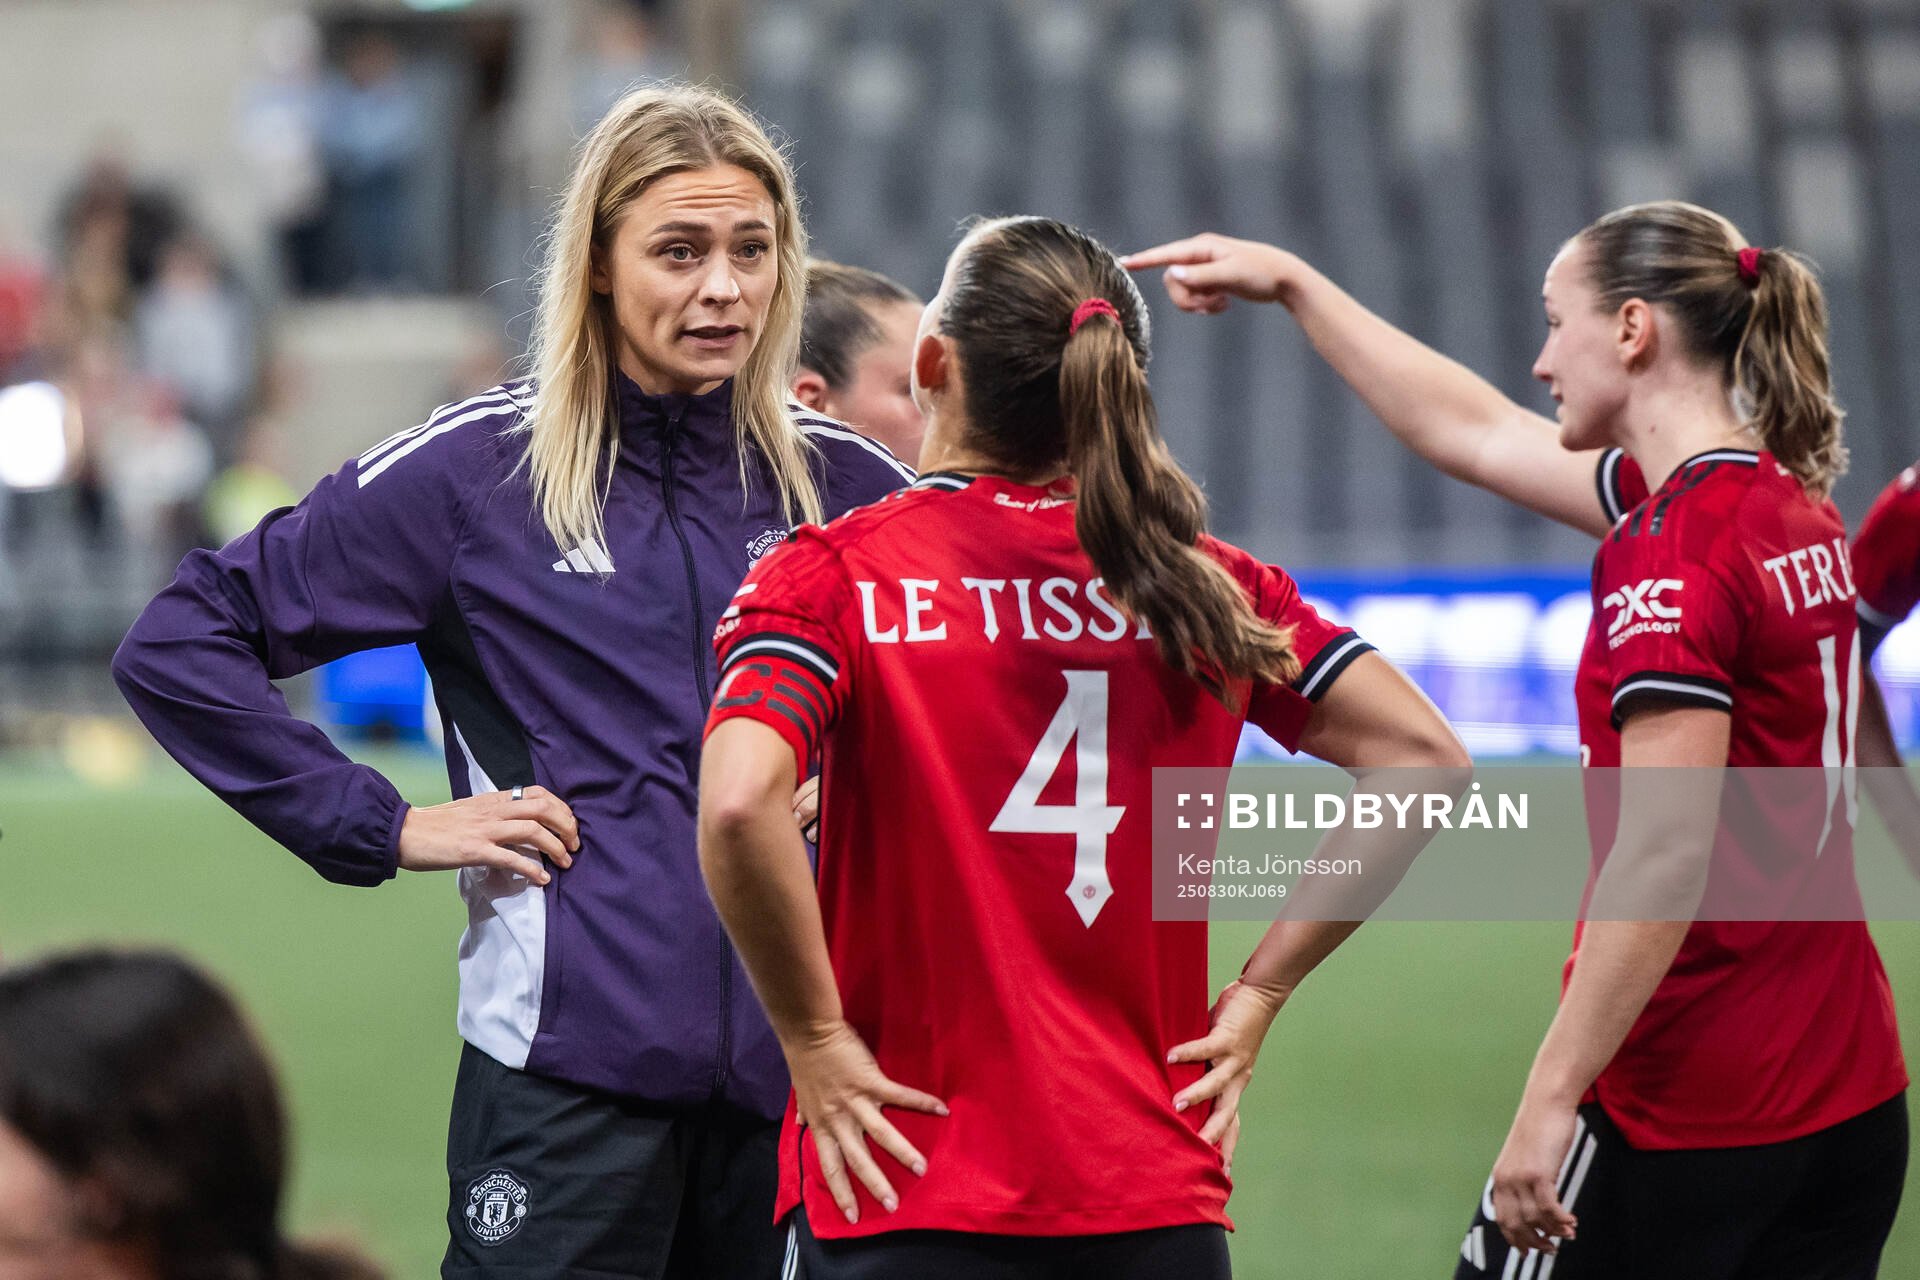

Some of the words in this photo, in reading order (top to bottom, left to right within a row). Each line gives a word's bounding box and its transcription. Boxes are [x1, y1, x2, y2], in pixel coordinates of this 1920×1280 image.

[856, 577, 948, 644] LE
[1602, 578, 1684, 637] DXC
[1608, 620, 1681, 651] TECHNOLOGY
[988, 669, 1127, 929] 4
[474, 1178, 523, 1202] MANCHESTER
[476, 1224, 511, 1237] UNITED
